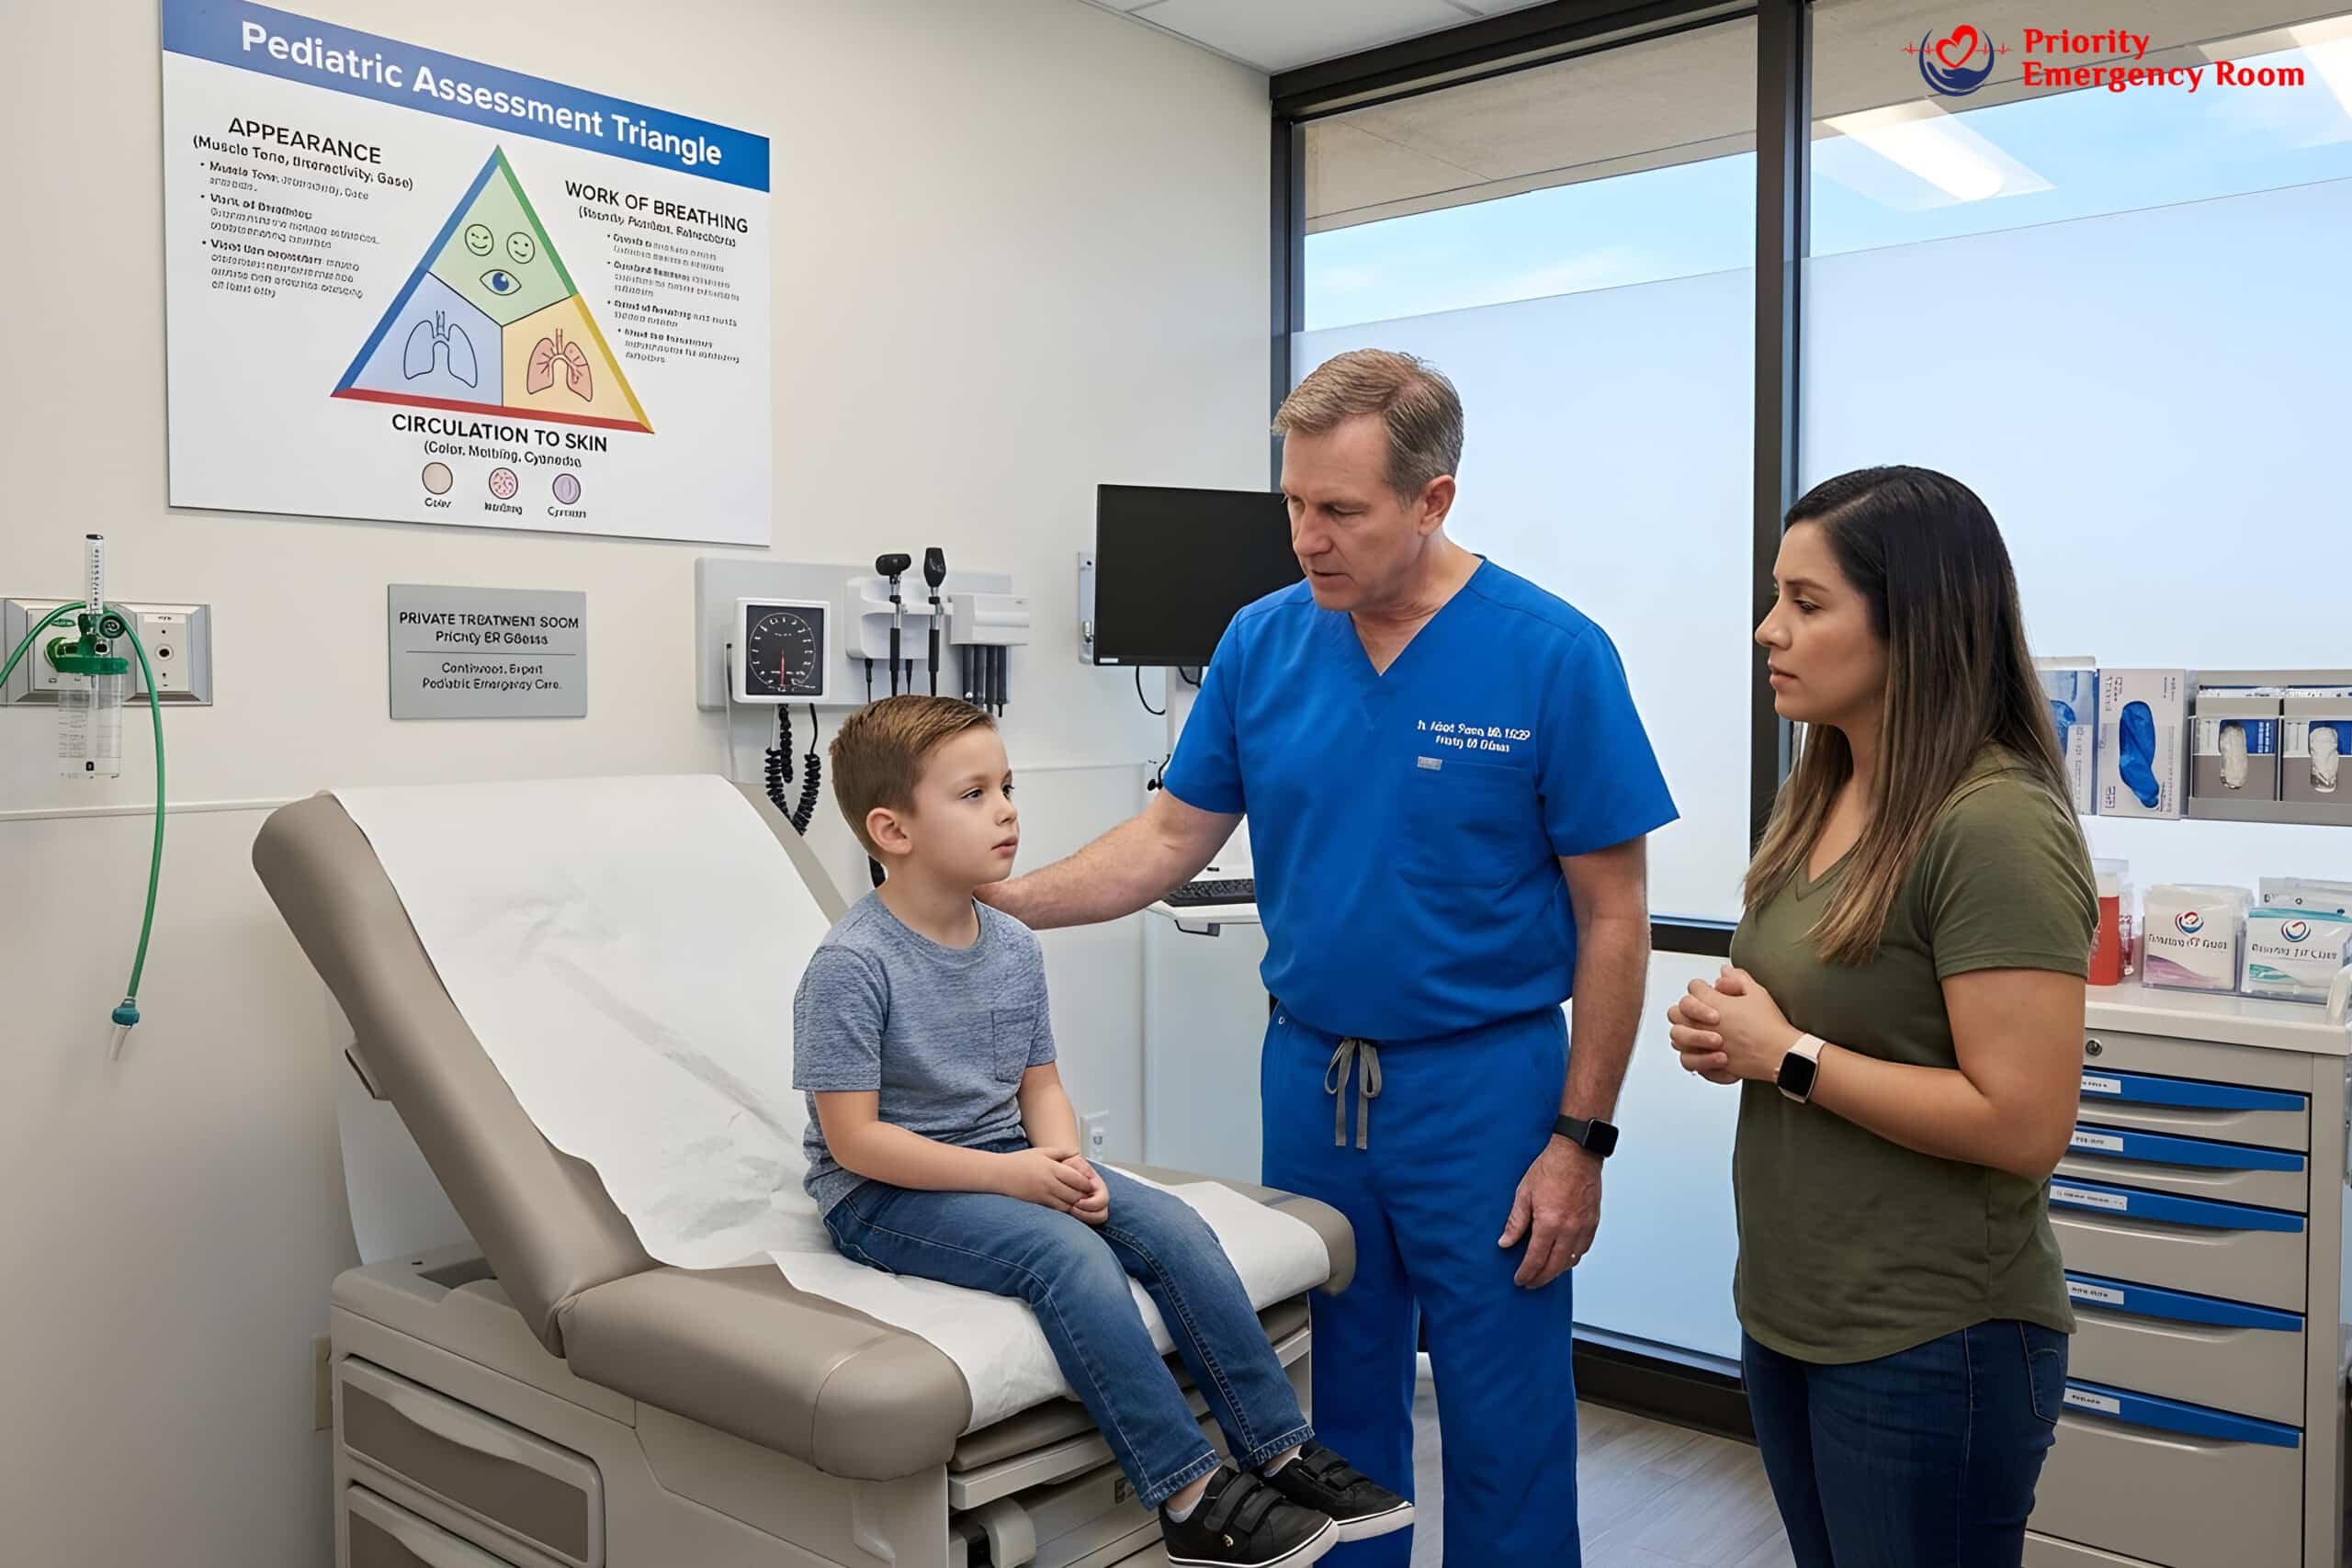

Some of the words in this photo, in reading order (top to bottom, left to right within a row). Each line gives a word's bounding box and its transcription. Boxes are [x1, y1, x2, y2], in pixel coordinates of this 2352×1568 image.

[242, 21, 402, 88] Pediatric
[413, 65, 604, 137] Assessment
[611, 114, 722, 166] Triangle
[229, 118, 381, 164] APPEARANCE
[565, 180, 619, 206] WORK
[625, 194, 649, 210] OF
[654, 200, 749, 233] BREATHING
[392, 414, 528, 444] CIRCULATION
[535, 430, 560, 446] TO
[565, 434, 607, 452] SKIN
[400, 612, 456, 626] PRIVATE
[484, 632, 501, 643] ER
